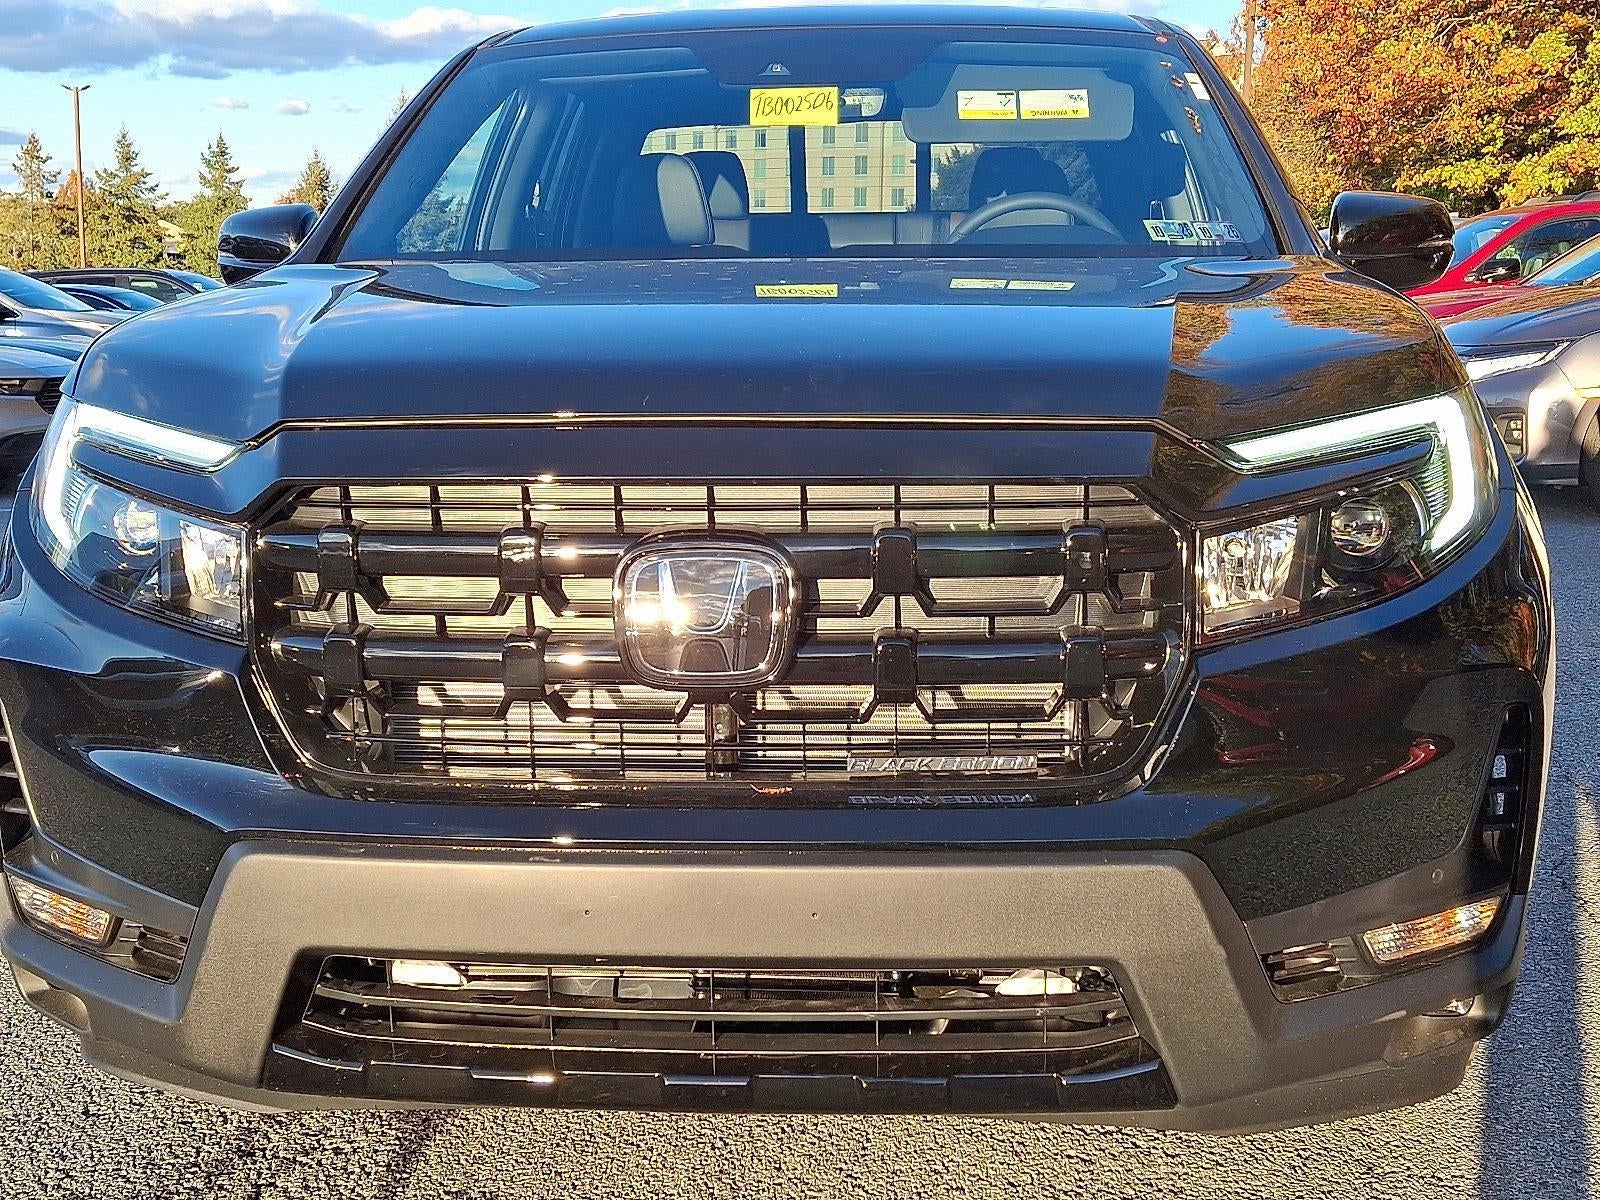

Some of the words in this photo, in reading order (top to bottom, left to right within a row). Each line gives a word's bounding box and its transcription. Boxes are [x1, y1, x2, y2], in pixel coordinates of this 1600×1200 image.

[752, 91, 835, 117] TB002506
[1031, 109, 1068, 117] WARNING
[1223, 224, 1239, 239] 26
[849, 757, 933, 771] BLACK
[939, 757, 1036, 770] EDITION
